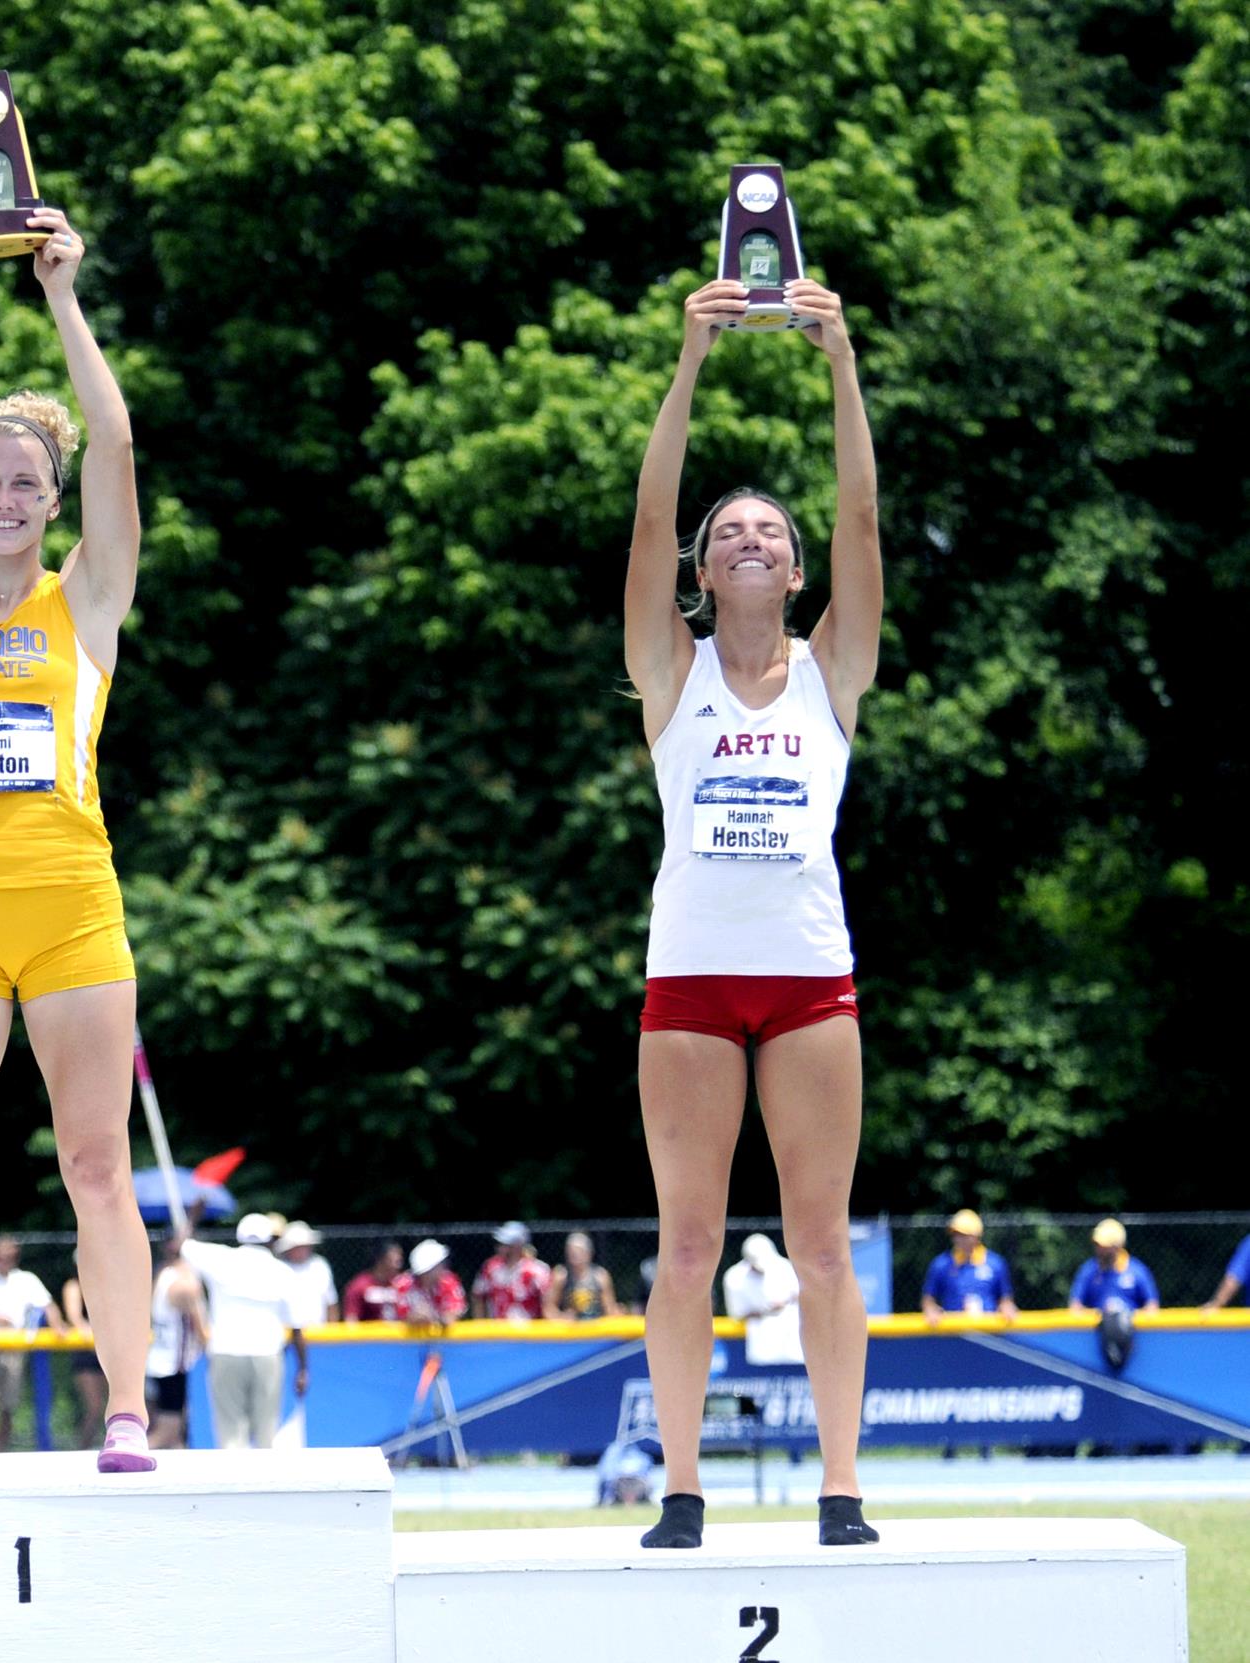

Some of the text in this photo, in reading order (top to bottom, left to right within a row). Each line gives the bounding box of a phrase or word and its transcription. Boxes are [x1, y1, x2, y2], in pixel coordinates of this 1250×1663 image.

[728, 810, 774, 824] Hannah
[713, 826, 789, 849] Hensley
[862, 1386, 1083, 1424] CHAMPIONSHIPS
[14, 1536, 32, 1603] 1
[739, 1606, 780, 1663] 2
